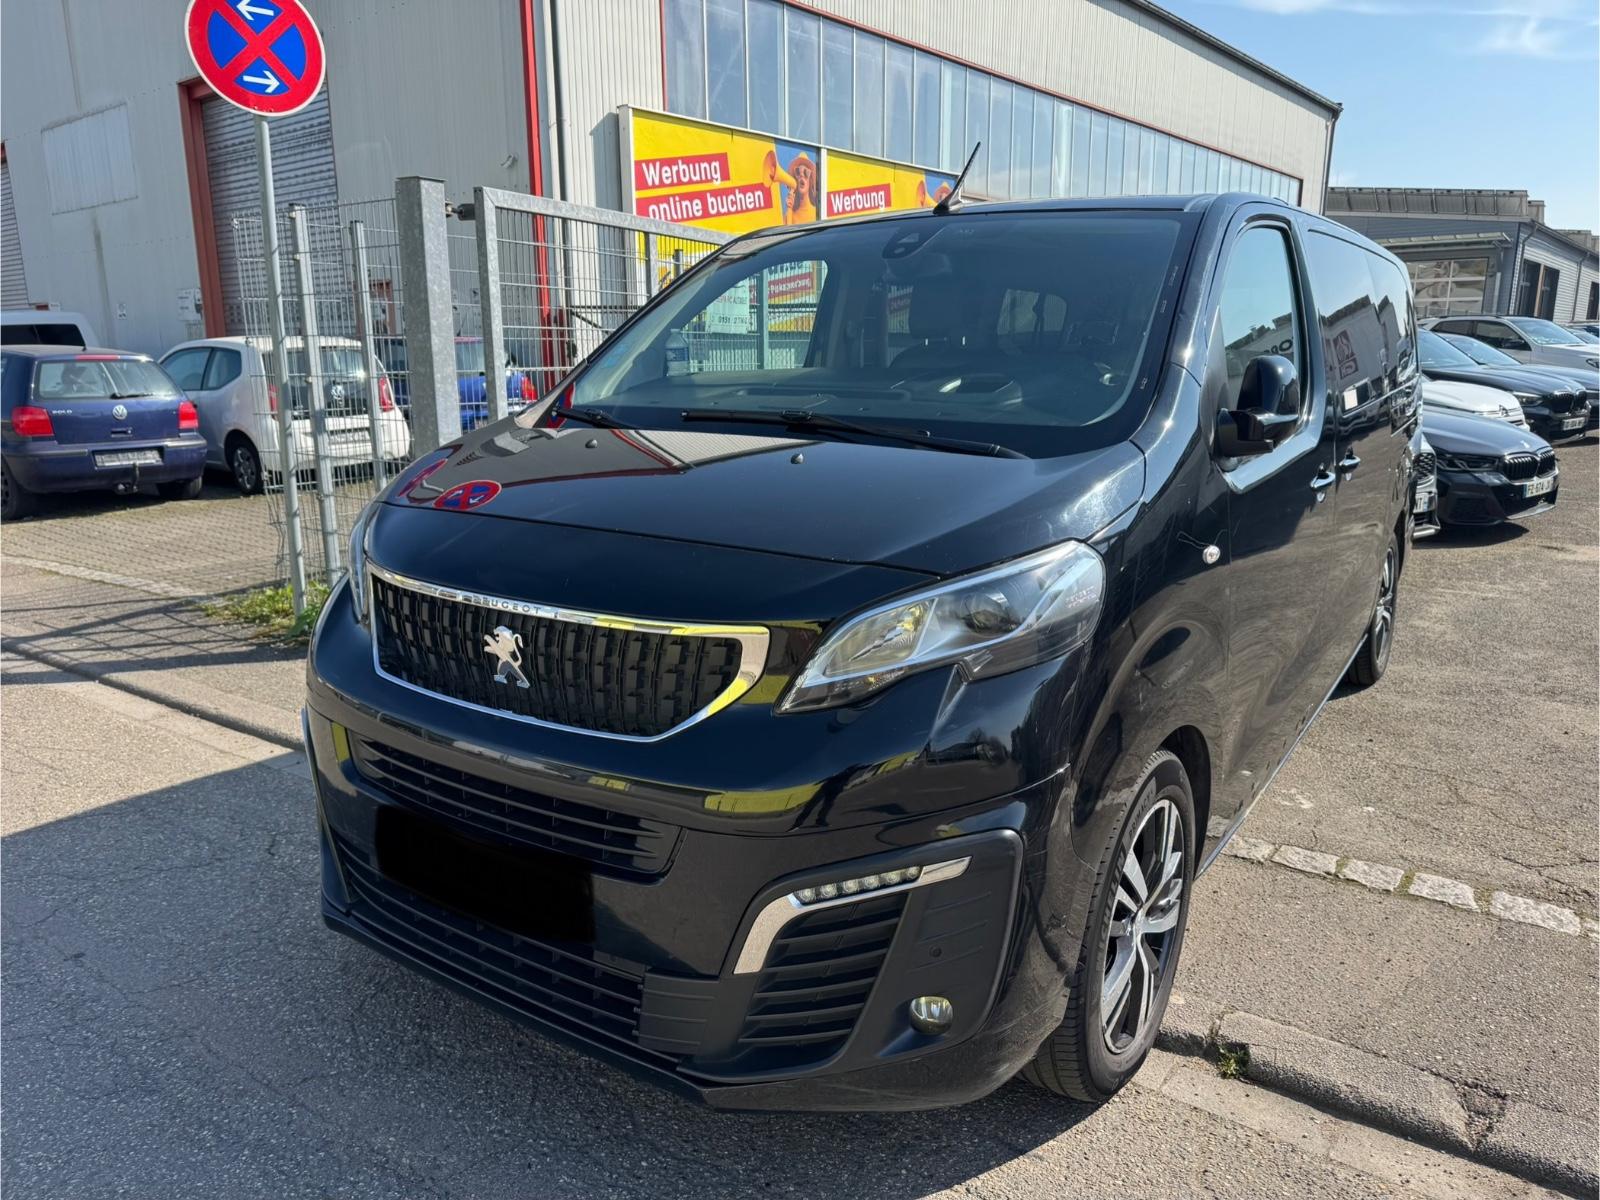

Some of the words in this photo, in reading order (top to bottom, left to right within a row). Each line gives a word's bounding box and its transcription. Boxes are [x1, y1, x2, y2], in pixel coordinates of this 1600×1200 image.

[642, 160, 720, 185] Werbung
[648, 196, 703, 220] online
[706, 189, 764, 214] buchen
[830, 190, 885, 212] Werbung
